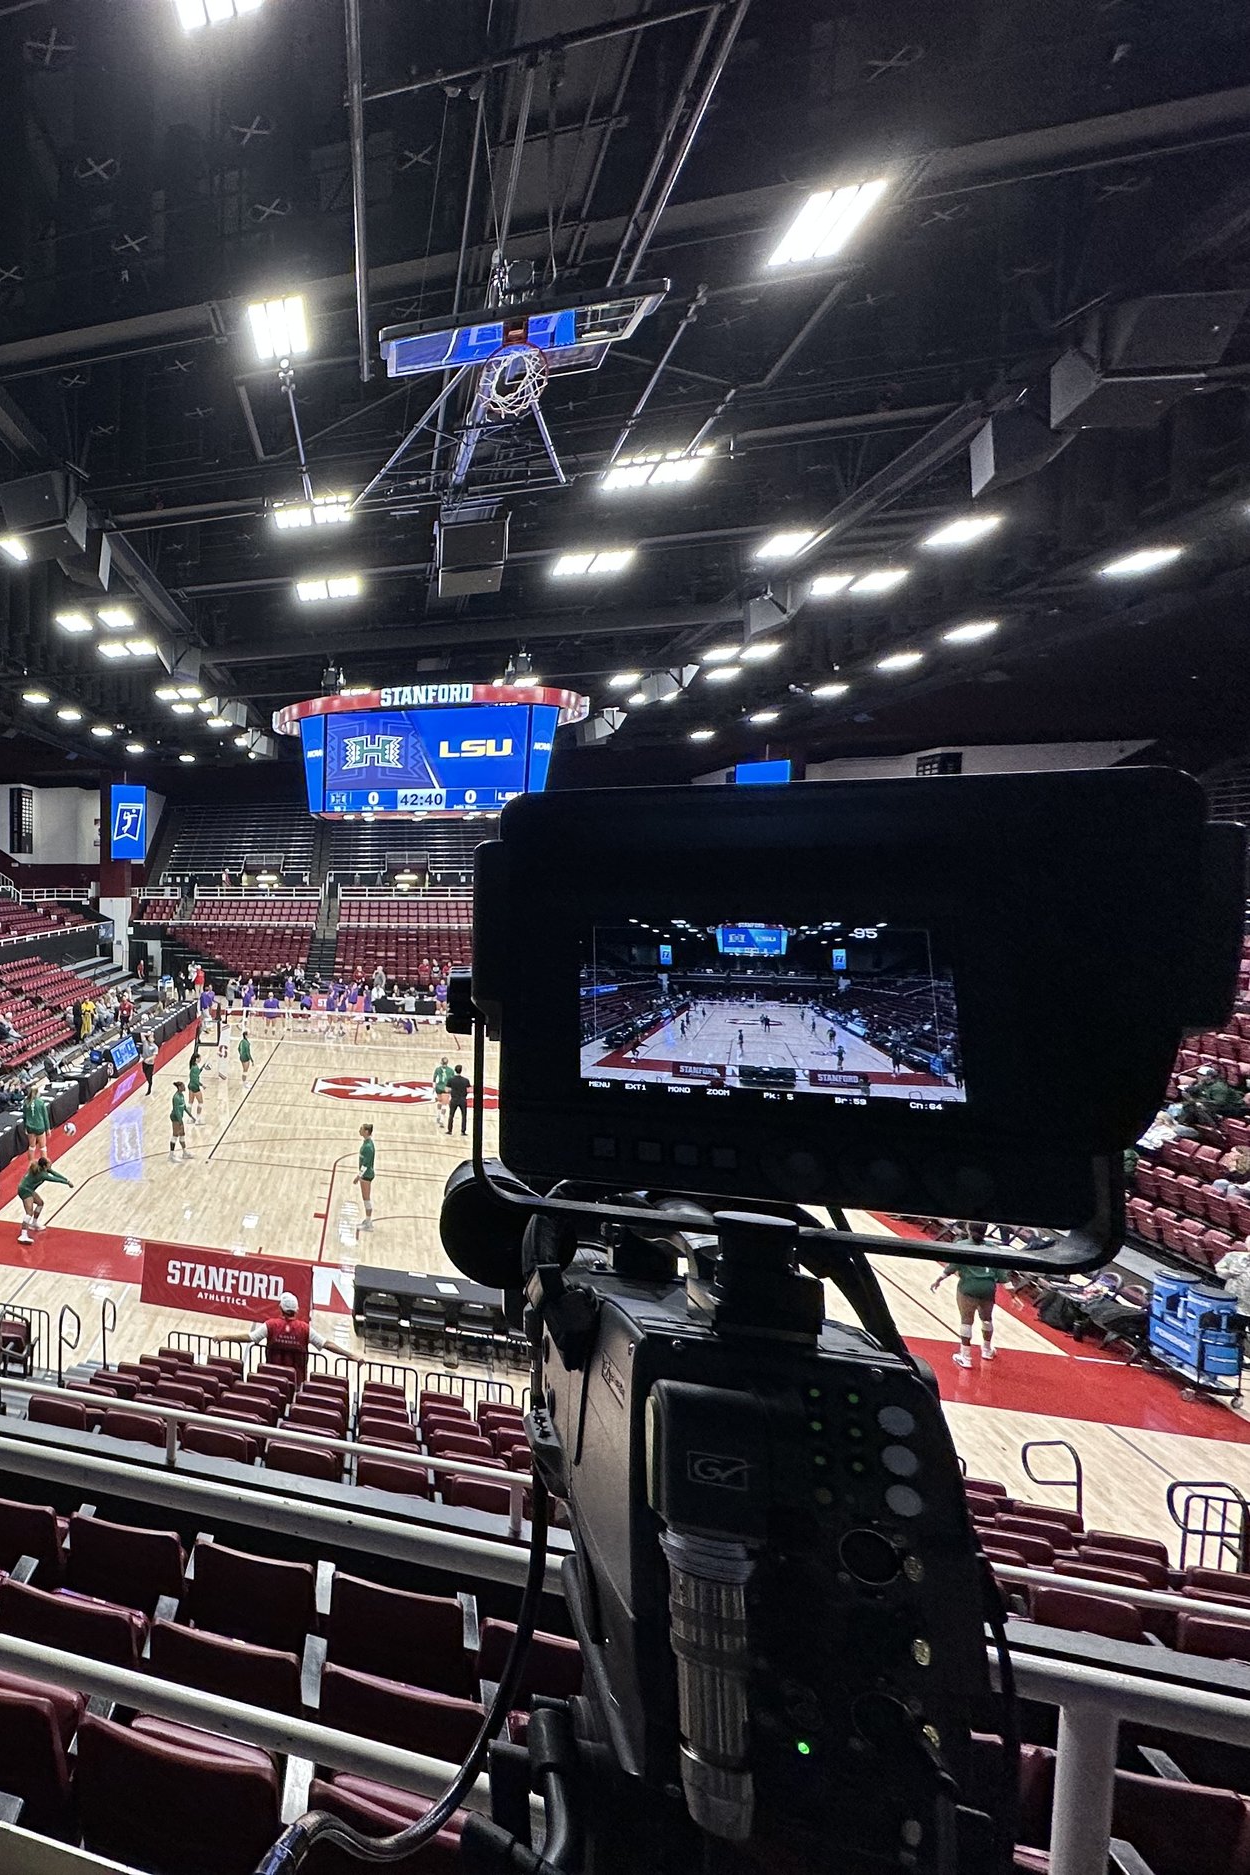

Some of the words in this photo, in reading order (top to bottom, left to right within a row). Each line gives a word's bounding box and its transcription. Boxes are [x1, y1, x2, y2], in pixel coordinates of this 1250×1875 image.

[380, 684, 474, 706] STANFORD
[439, 739, 513, 758] LSU
[368, 791, 379, 805] 0
[400, 793, 443, 806] 42:40
[464, 790, 477, 804] 0
[588, 1080, 611, 1089] MENU
[625, 1083, 647, 1091] EXT1
[668, 1086, 691, 1094] MONO
[706, 1088, 730, 1097] ZOOM
[166, 1259, 284, 1301] STANFORD
[197, 1291, 247, 1306] ATHLETICS
